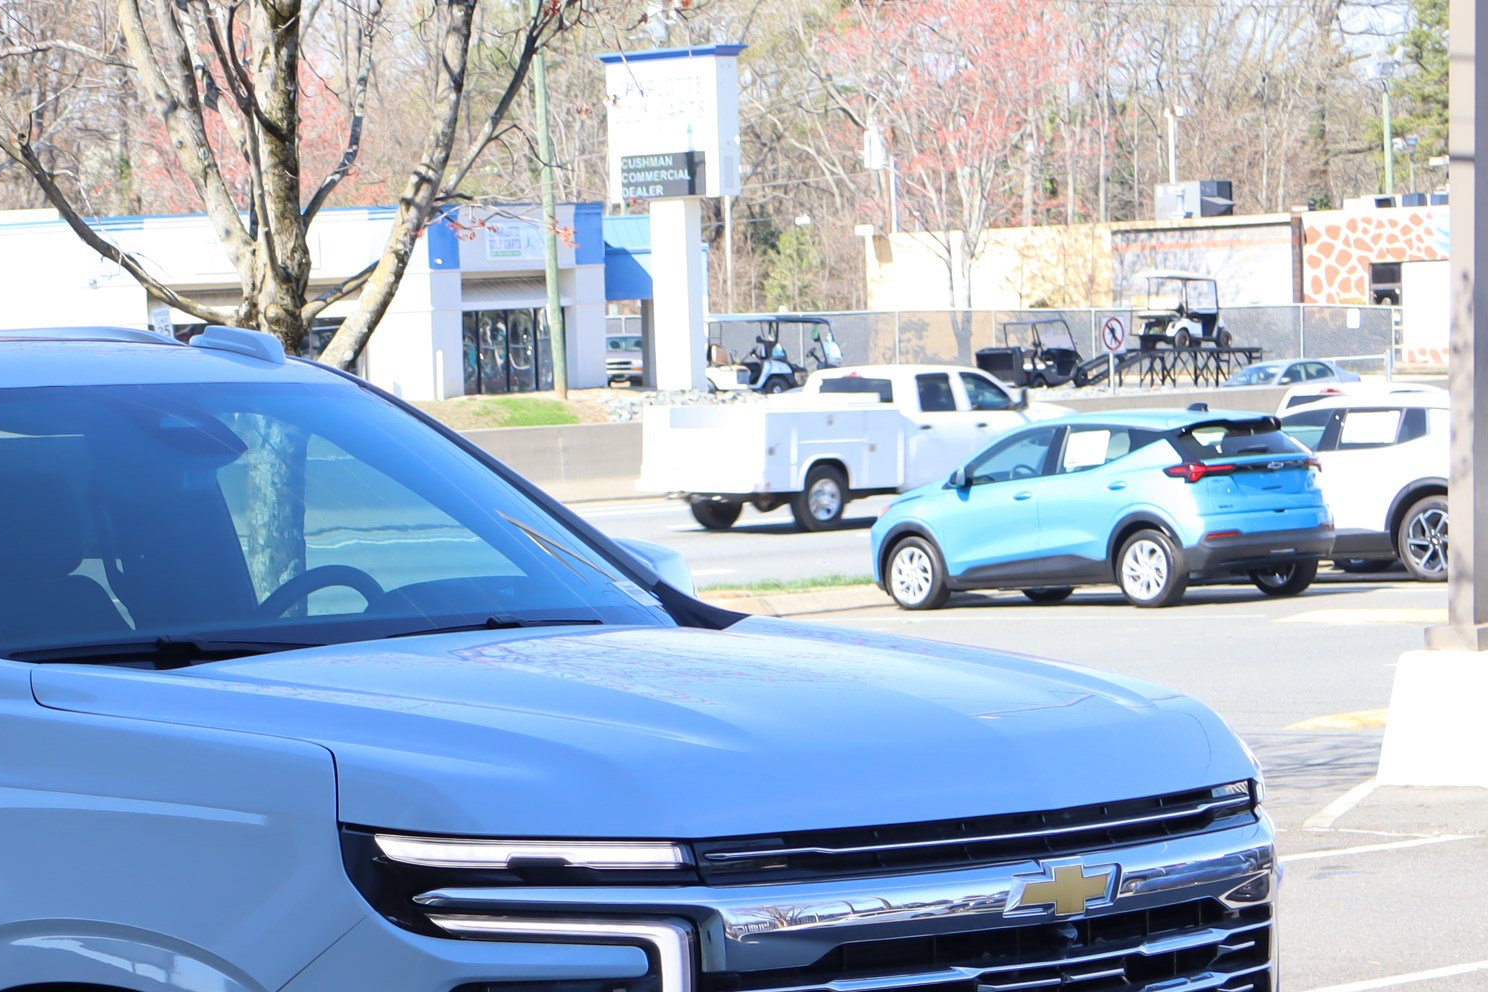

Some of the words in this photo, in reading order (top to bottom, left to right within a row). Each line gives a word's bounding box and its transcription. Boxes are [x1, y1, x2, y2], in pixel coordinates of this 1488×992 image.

[622, 155, 673, 169] CUSHMAN
[622, 168, 691, 183] COMMERCIAL
[622, 185, 664, 198] DEALER
